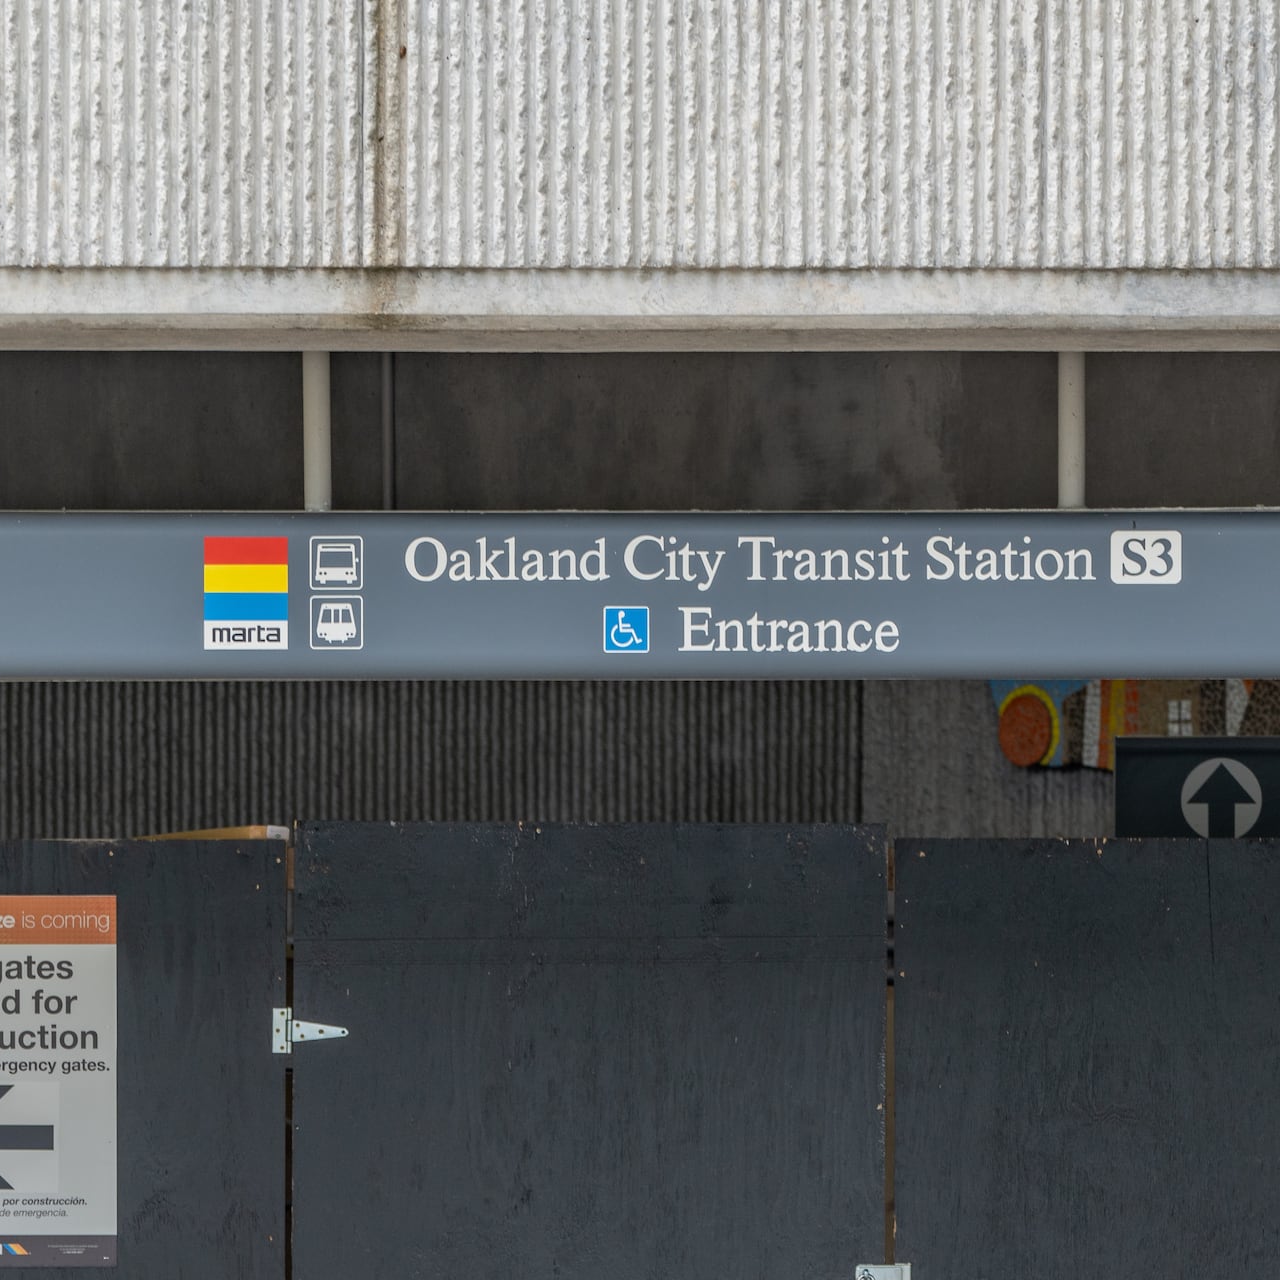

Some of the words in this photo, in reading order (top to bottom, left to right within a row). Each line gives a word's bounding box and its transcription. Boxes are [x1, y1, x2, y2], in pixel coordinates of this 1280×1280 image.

[403, 535, 611, 583] Oakland
[622, 534, 726, 591] City
[737, 535, 911, 582] Transit
[925, 534, 1097, 582] Station
[1120, 536, 1175, 579] S3
[212, 625, 281, 643] marta
[677, 606, 900, 653] Entrance
[21, 910, 36, 929] is
[40, 910, 111, 932] coming
[31, 988, 78, 1014] for
[61, 1059, 111, 1074] gates.
[2, 1198, 20, 1207] por
